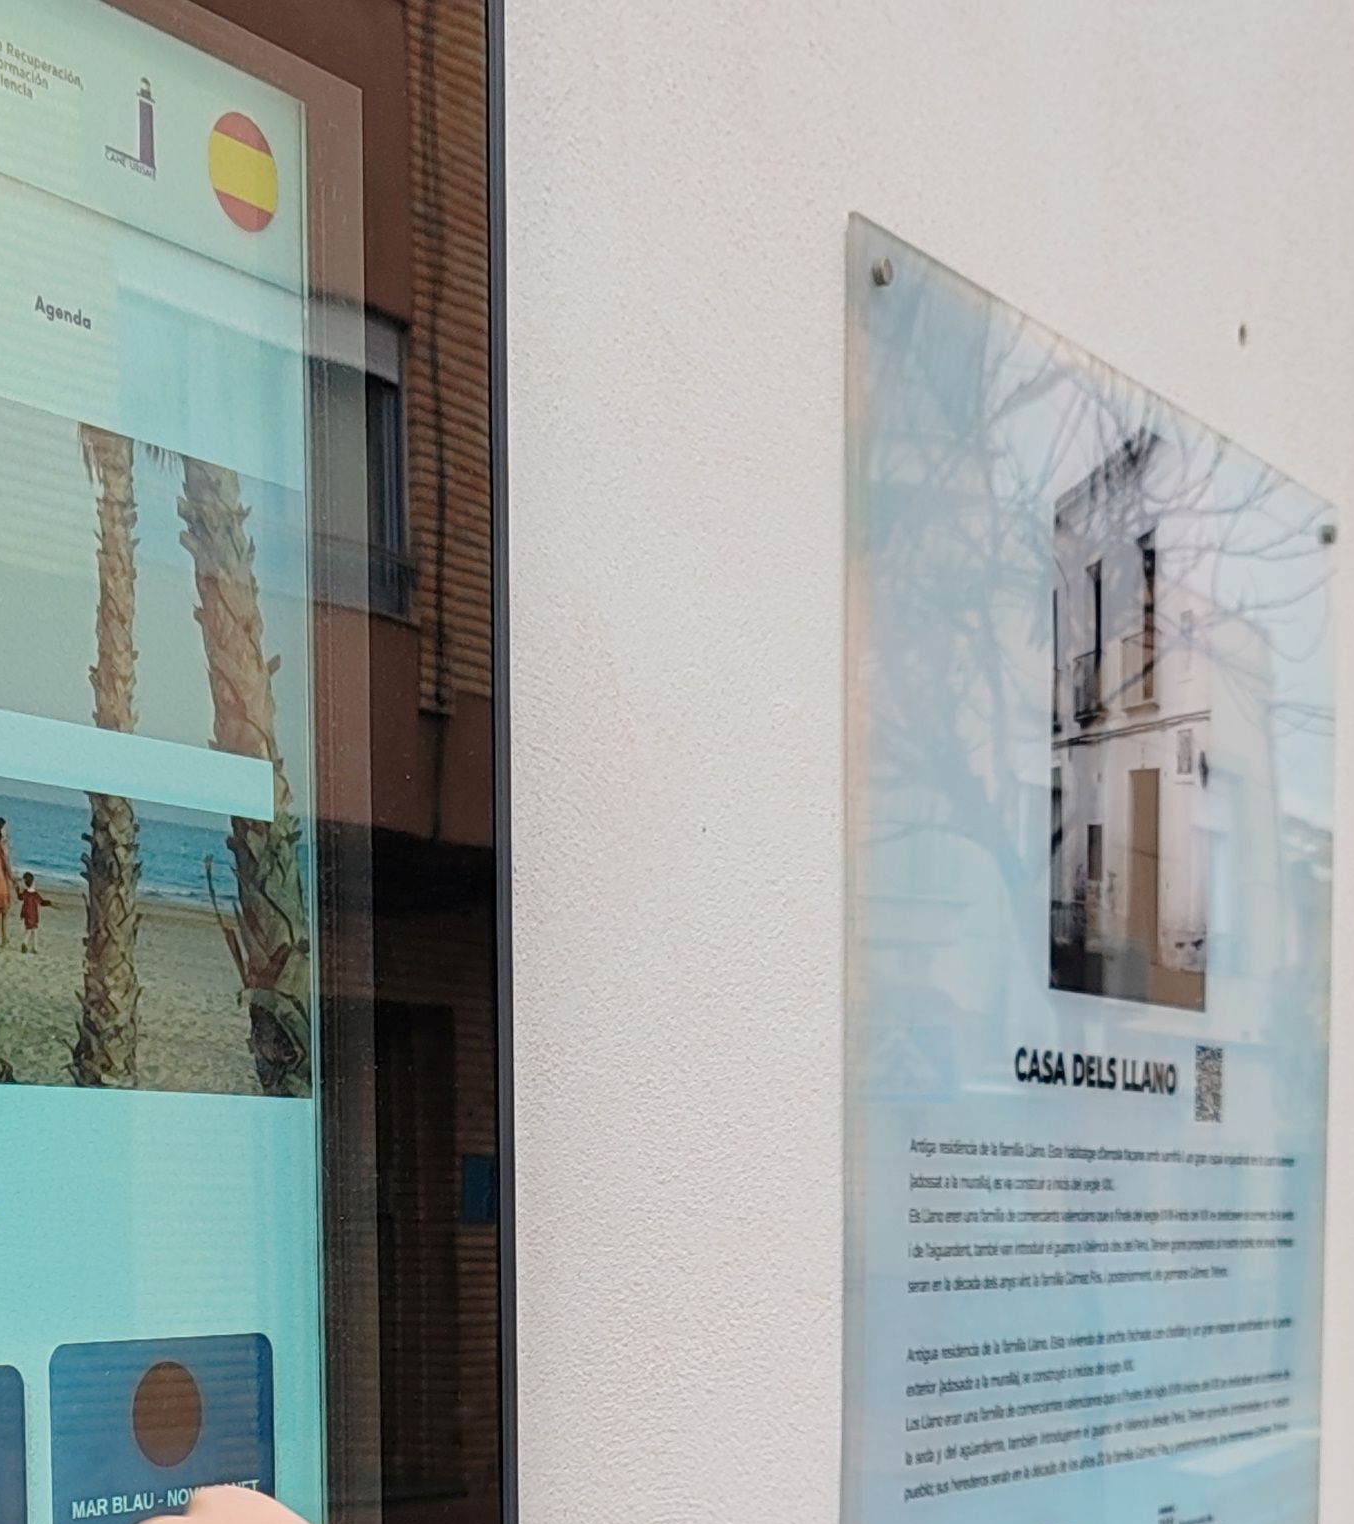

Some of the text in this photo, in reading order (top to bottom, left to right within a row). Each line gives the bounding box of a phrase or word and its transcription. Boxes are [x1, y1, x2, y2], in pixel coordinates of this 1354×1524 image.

[6, 42, 84, 91] Recuperación,
[35, 295, 92, 330] Agenda
[1015, 1046, 1176, 1096] CASA DELS LLANO
[72, 1498, 108, 1519] MAR
[112, 1492, 155, 1514] BLAU
